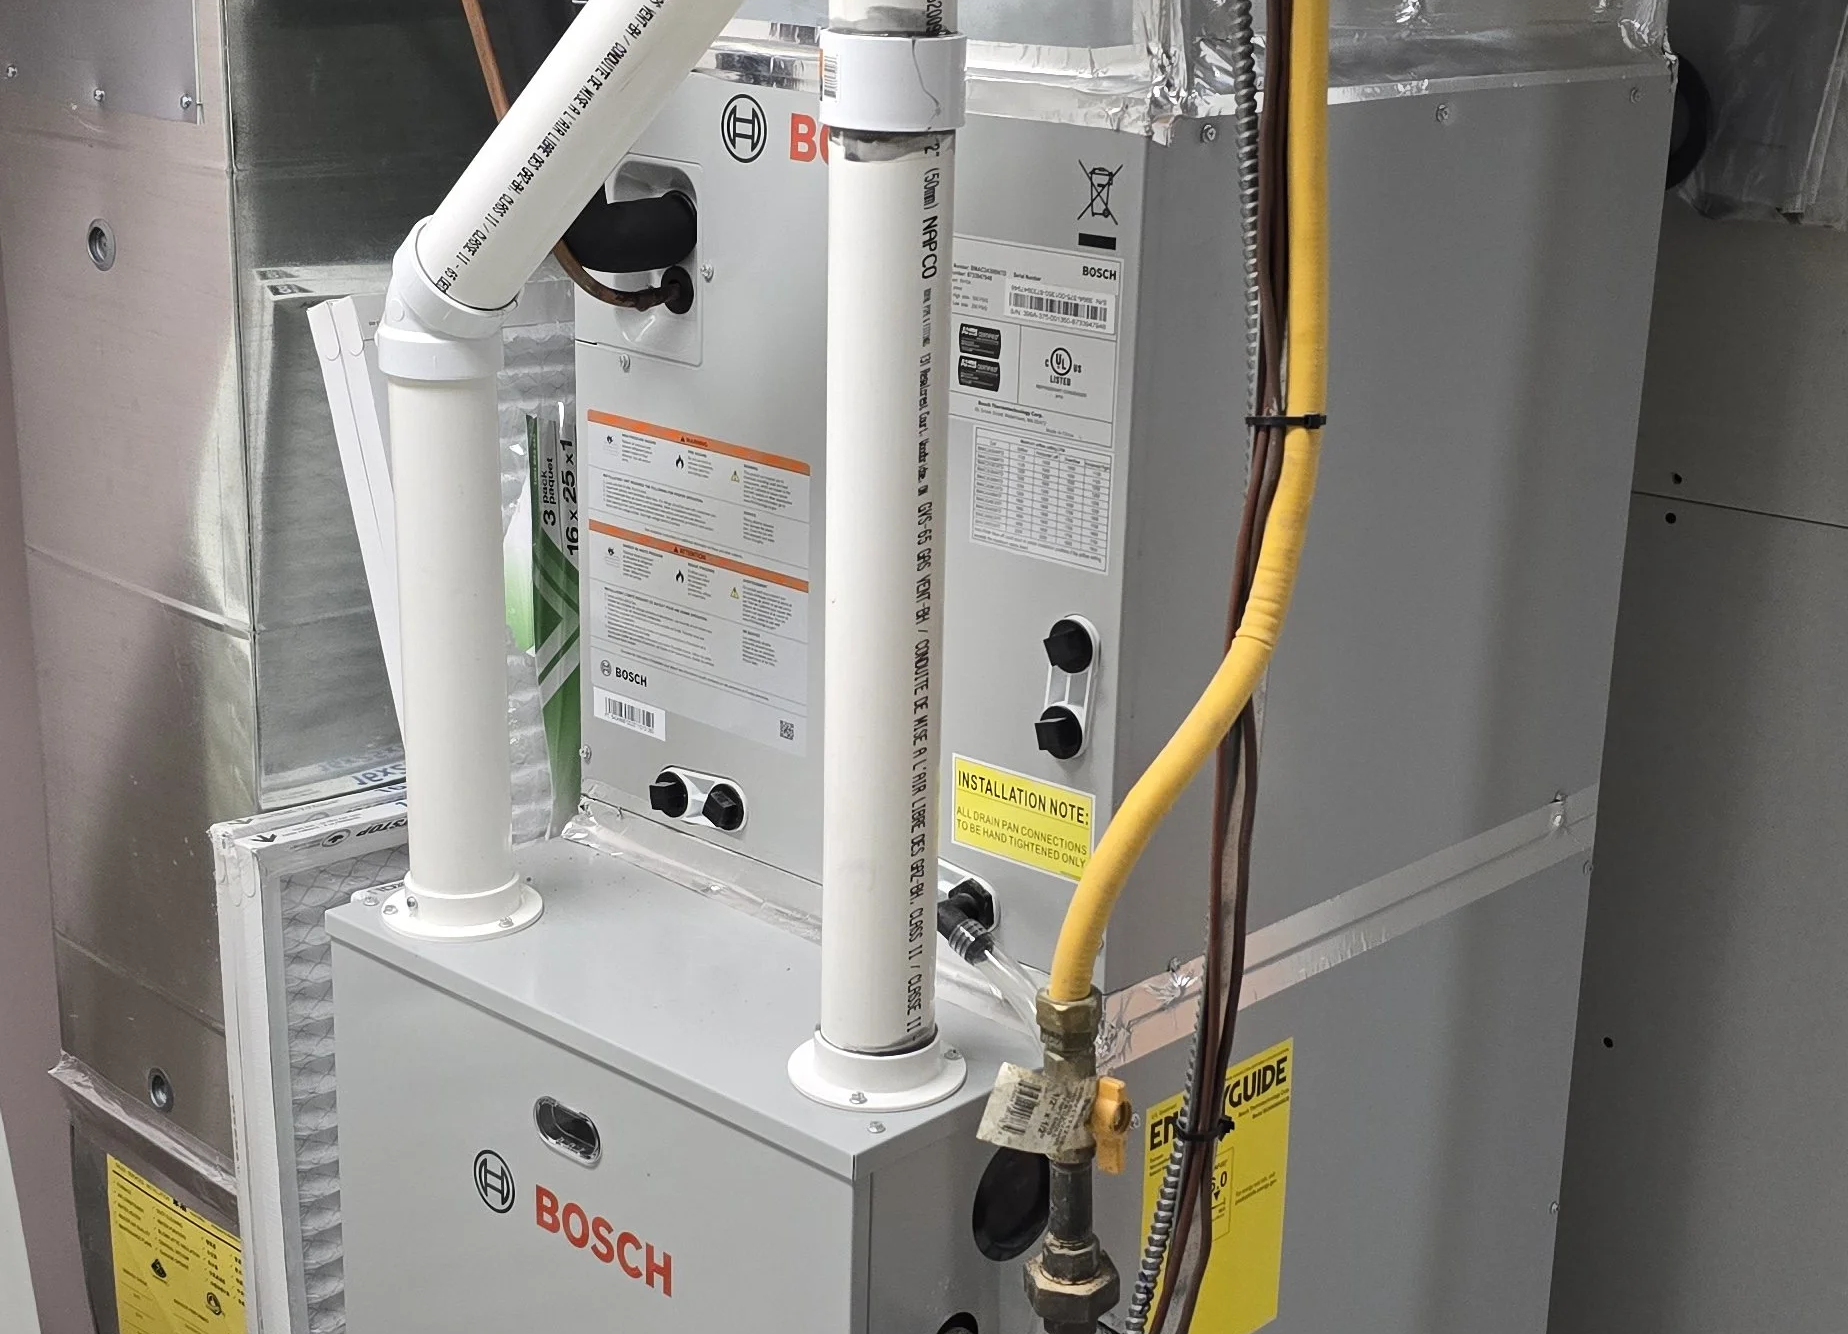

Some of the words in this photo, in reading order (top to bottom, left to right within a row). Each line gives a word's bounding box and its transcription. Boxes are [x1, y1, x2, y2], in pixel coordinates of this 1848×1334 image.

[594, 42, 628, 80] CONDUITE
[586, 75, 603, 90] DE
[573, 85, 595, 109] MISE
[537, 131, 561, 157] LIBRE
[527, 153, 544, 170] DES
[492, 193, 514, 217] CLASS
[463, 229, 487, 256] CLASSE
[922, 215, 938, 280] NAPCO
[1082, 265, 1117, 281] BOSCH
[1050, 375, 1071, 386] LISTED
[560, 439, 573, 449] 1
[565, 454, 574, 465] x
[561, 470, 577, 503] 25
[543, 508, 557, 527] 3
[569, 510, 578, 521] x
[917, 501, 932, 546] GVS-65
[565, 526, 579, 556] 16
[917, 547, 931, 572] GAS
[915, 573, 931, 625] VENT-BH
[615, 666, 648, 688] BOSCH
[914, 638, 930, 696] CONDUITE
[913, 696, 928, 715] DE
[912, 715, 928, 746] MISE
[958, 770, 1046, 812] INSTALLATION
[1050, 797, 1089, 826] NOTE:
[911, 796, 926, 833] LIBRE
[956, 806, 970, 819] ALL
[973, 811, 1000, 828] DRAIN
[1001, 819, 1019, 834] PAN
[1020, 826, 1087, 855] CONNECTIONS
[910, 833, 926, 857] DES
[957, 819, 968, 831] TO
[970, 823, 981, 836] BE
[983, 827, 1007, 844] HAND
[1008, 836, 1060, 860] TIGHTENED
[1061, 853, 1086, 870] ONLY
[908, 907, 924, 942] CLASS
[906, 973, 922, 1016] CLASSE
[535, 1183, 672, 1298] BOSCH
